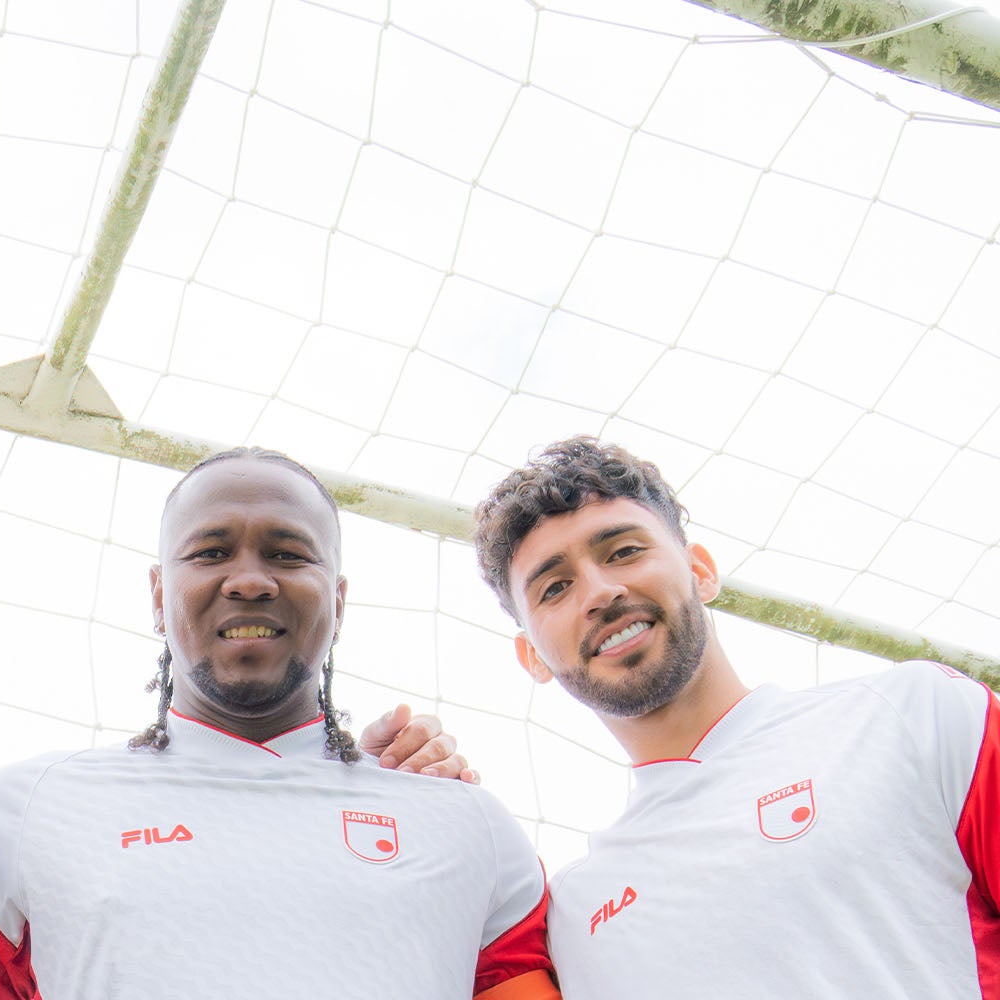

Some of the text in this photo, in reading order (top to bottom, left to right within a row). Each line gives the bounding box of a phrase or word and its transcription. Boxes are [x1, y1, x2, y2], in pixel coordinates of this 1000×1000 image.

[758, 785, 794, 805] SANTA
[344, 812, 394, 826] SANTA FE
[121, 824, 194, 849] FILA
[590, 886, 637, 936] FILA
